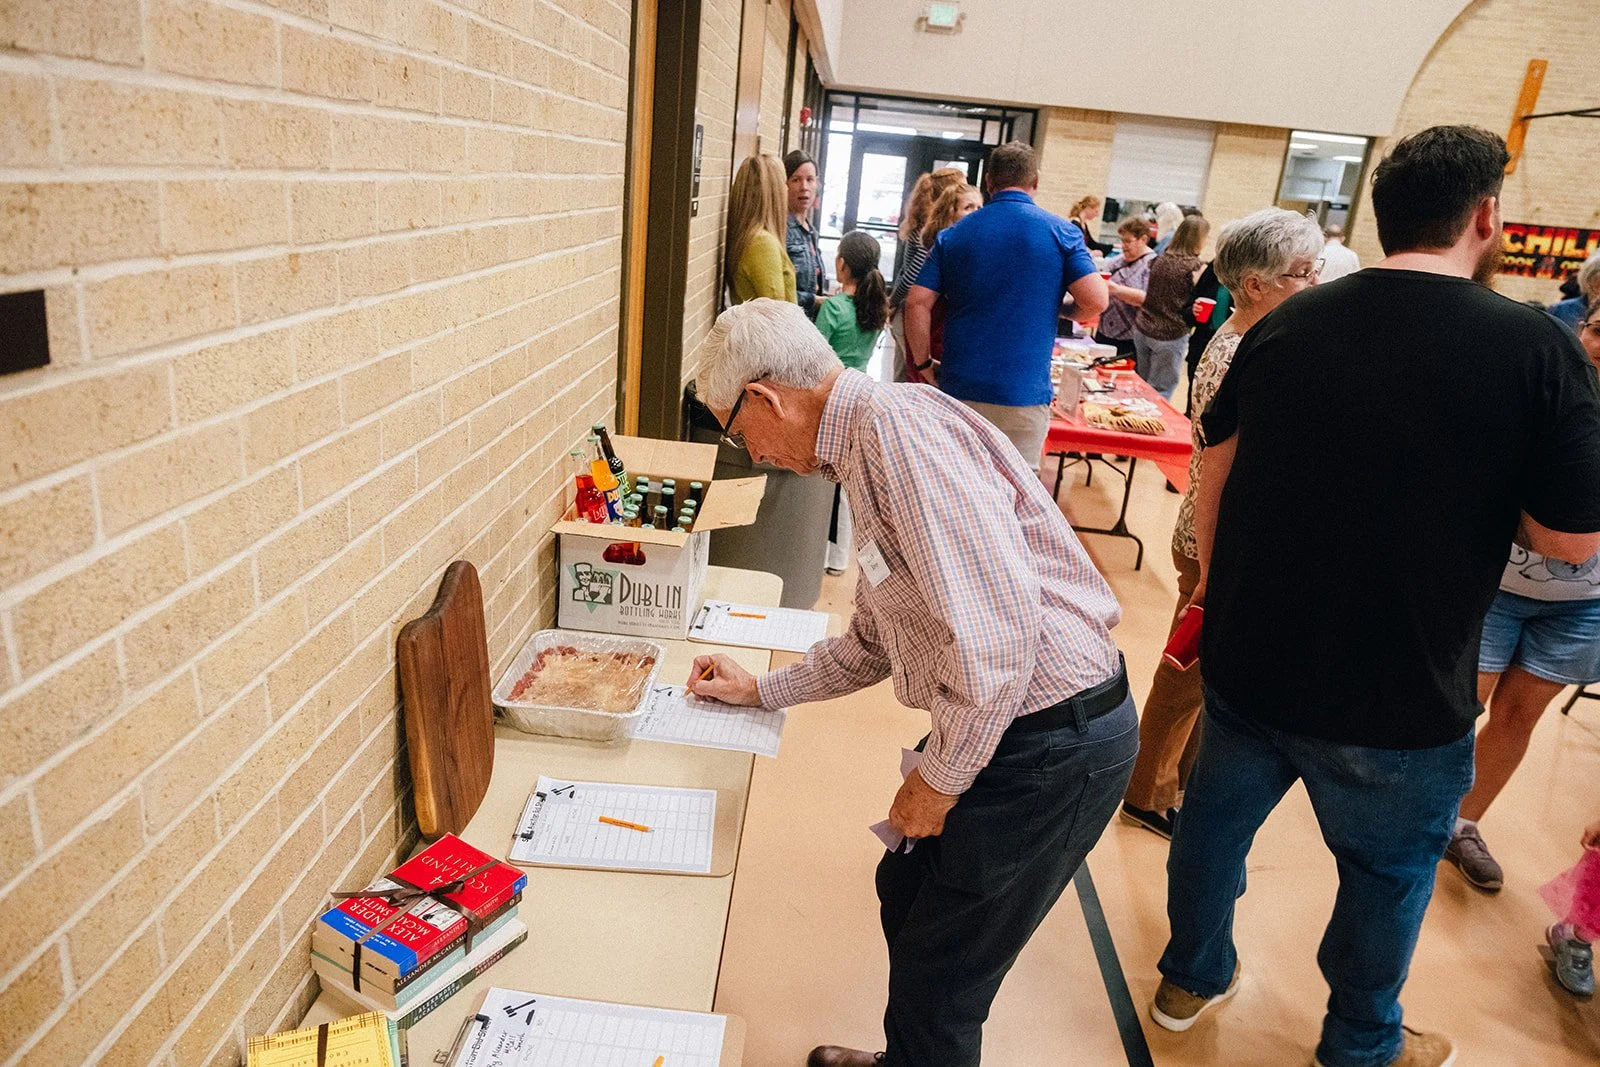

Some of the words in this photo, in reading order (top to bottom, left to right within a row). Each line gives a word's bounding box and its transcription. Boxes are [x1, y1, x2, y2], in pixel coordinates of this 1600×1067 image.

[619, 572, 682, 609] DUBLIN
[619, 605, 655, 618] BOTTLING
[658, 609, 681, 620] WORKS
[445, 854, 488, 880] SREET
[358, 896, 393, 917] SMITH
[349, 902, 420, 942] ALEXNDER
[396, 916, 431, 936] McCAL
[396, 960, 432, 988] ALEXANDER
[432, 943, 455, 961] McCALL
[455, 933, 467, 944] SMI
[418, 982, 457, 1013] ALEXANDER
[440, 985, 461, 1002] SMITH
